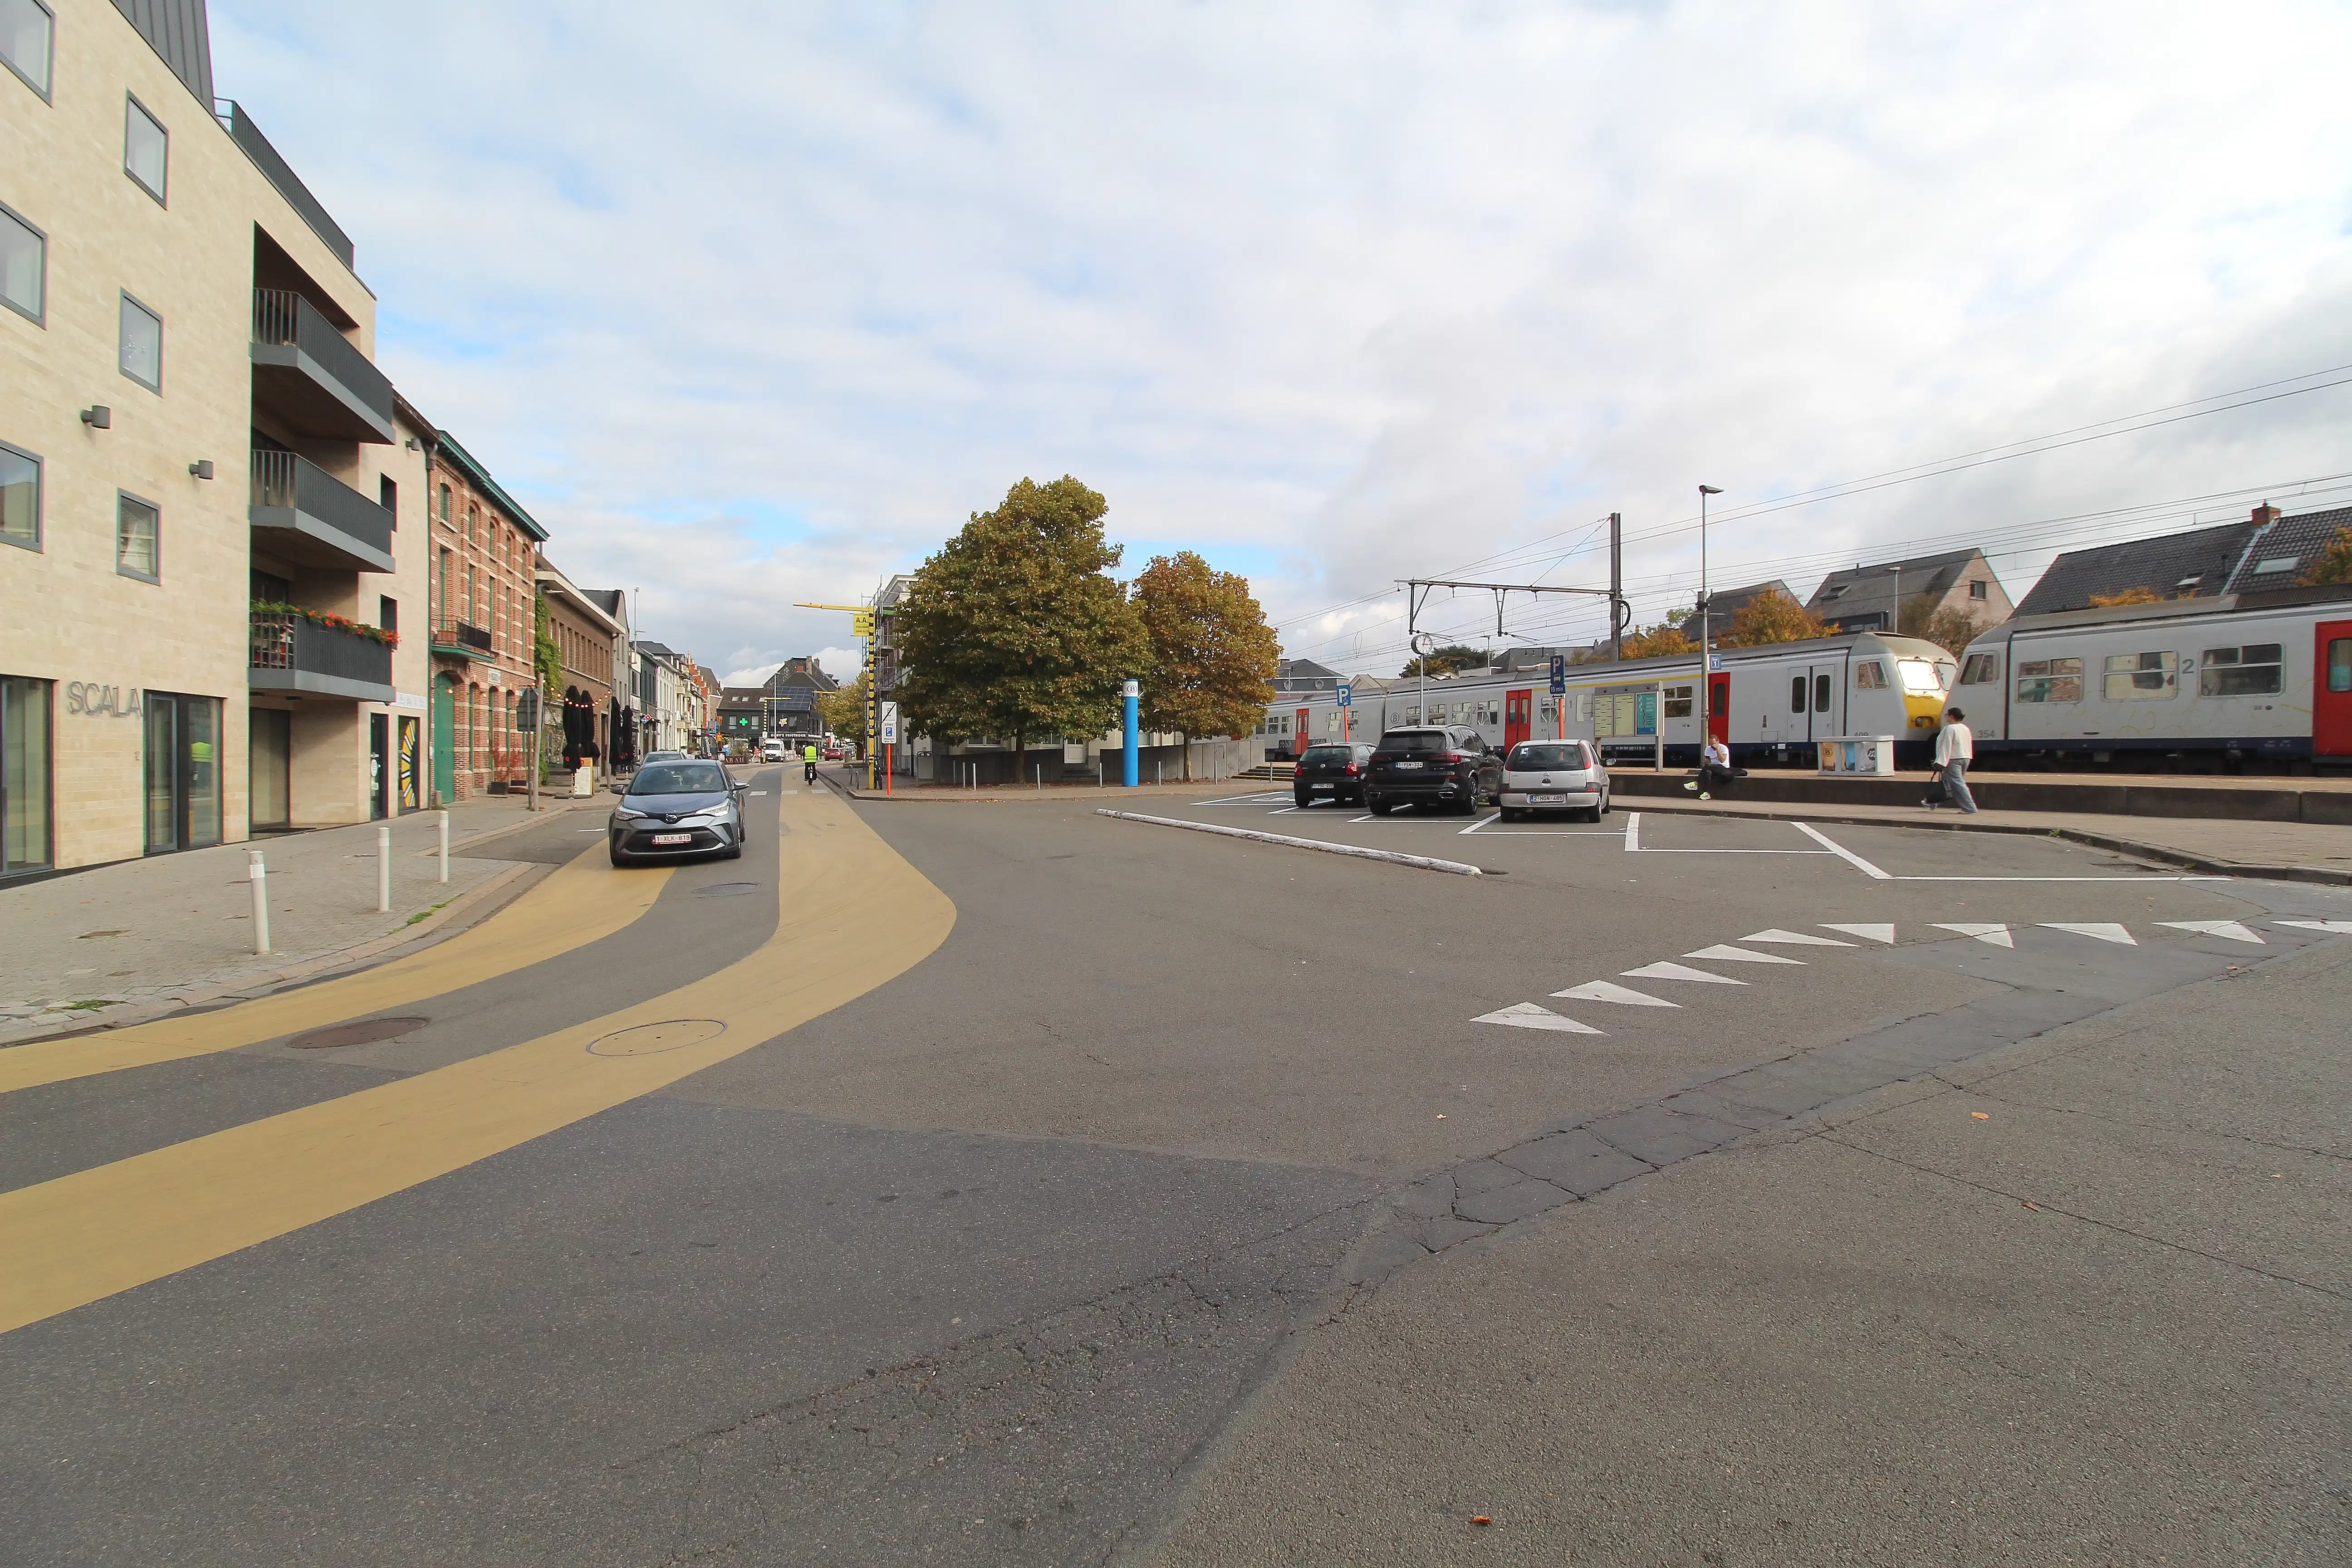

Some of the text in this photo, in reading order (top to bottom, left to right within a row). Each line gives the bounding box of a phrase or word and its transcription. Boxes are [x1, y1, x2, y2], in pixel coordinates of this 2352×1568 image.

[1553, 658, 1560, 672] P
[2182, 658, 2194, 674] 2
[68, 681, 143, 717] SCALA
[1338, 688, 1348, 703] P
